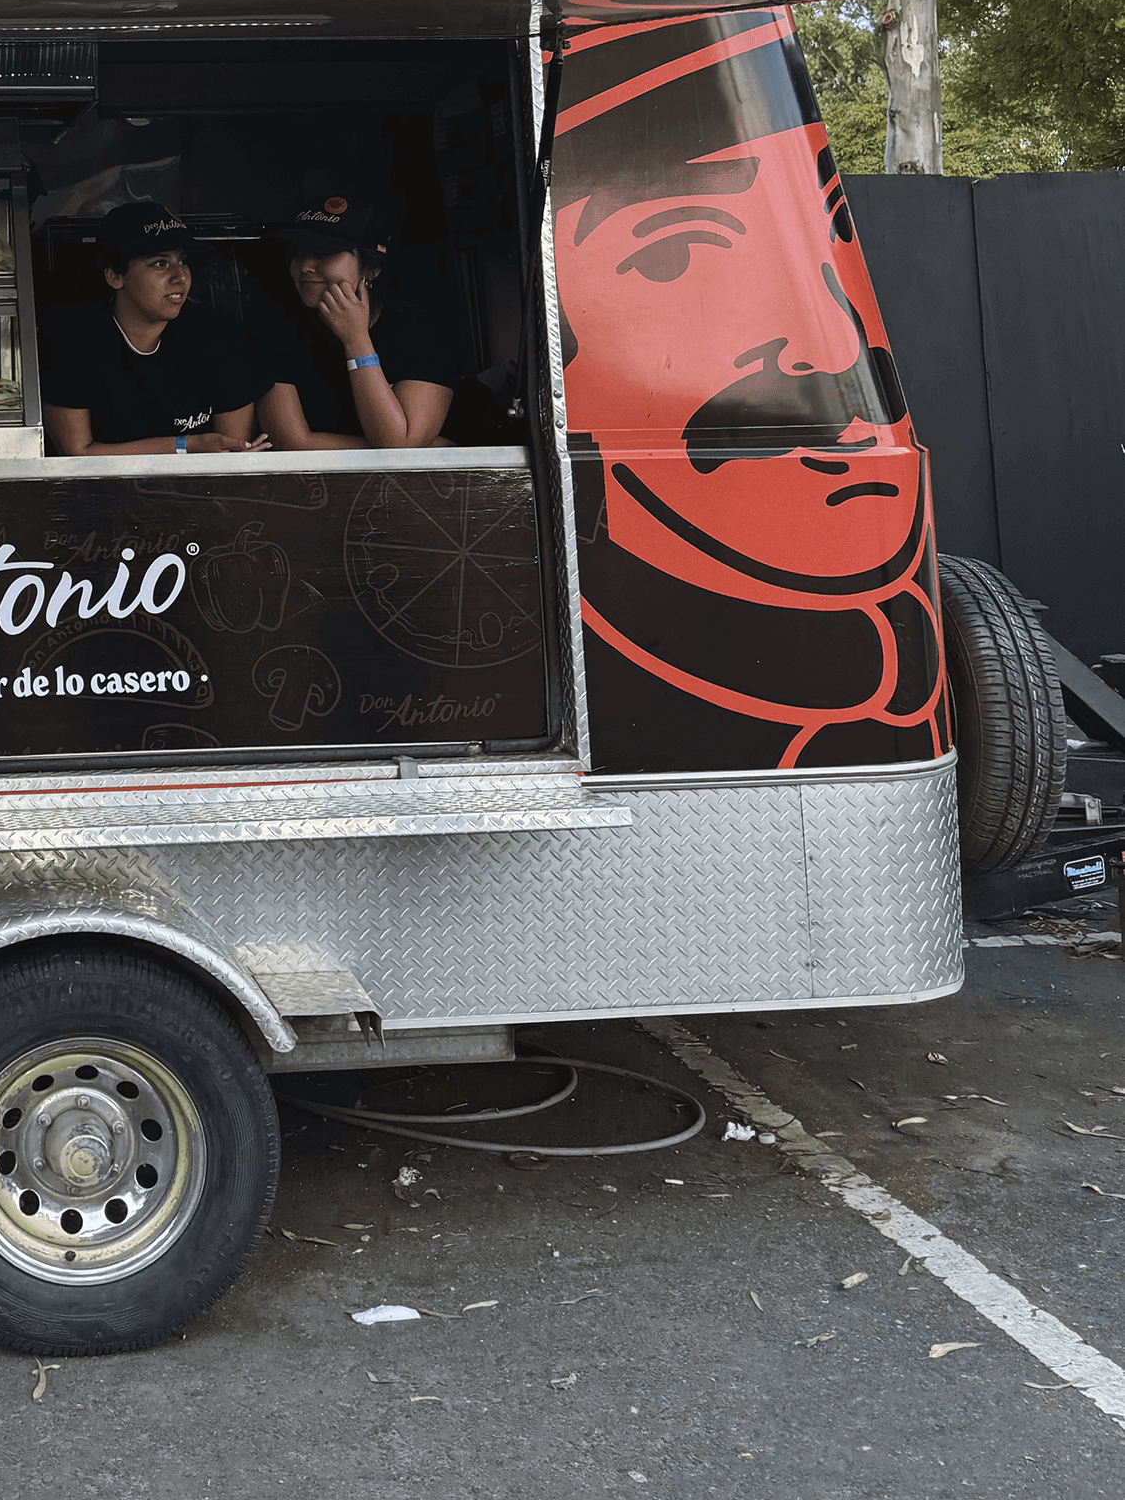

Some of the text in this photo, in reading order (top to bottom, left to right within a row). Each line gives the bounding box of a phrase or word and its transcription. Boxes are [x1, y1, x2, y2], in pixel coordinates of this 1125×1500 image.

[13, 666, 50, 698] de
[55, 665, 85, 696] lo
[90, 670, 191, 695] casero
[359, 694, 396, 714] Don
